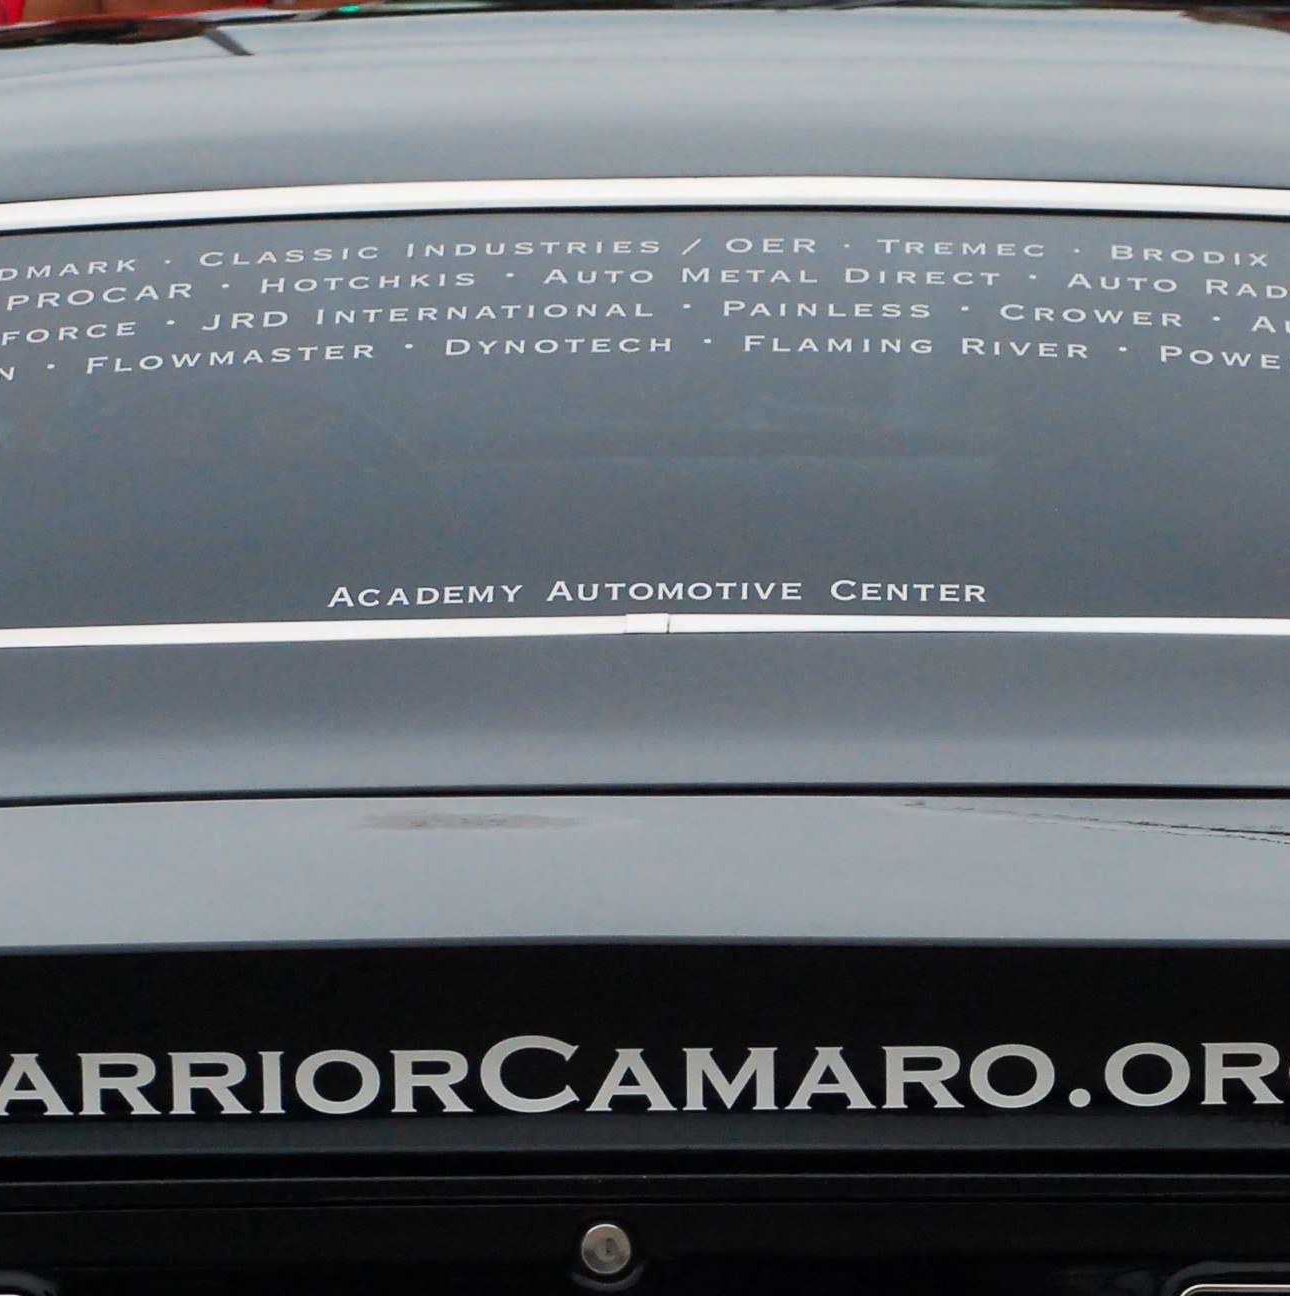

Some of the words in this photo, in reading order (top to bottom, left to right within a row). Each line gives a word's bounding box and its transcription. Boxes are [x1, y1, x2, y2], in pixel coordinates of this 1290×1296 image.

[199, 246, 379, 267] CLASSIC
[406, 240, 660, 258] INDUSTRIES
[725, 237, 816, 254] OER
[876, 239, 1044, 258] TREMEC
[1110, 244, 1268, 267] BRODIX
[6, 282, 192, 312] PROCAR
[260, 272, 475, 294] HOTCHKIS
[542, 268, 654, 285] AUTO
[681, 267, 818, 284] METAL
[844, 267, 1000, 286] DIRECT
[1067, 273, 1178, 293] AUTO
[1205, 278, 1288, 299] RAD
[201, 310, 289, 331] JRD
[316, 303, 654, 325] INTERNATIONAL
[723, 300, 930, 319] PAINLESS
[999, 303, 1183, 328] CROWER
[86, 344, 374, 375] FLOWMASTER
[444, 337, 672, 356] DYNOTECH
[743, 334, 933, 354] FLAMING
[961, 337, 1088, 359] RIVER
[327, 584, 523, 608] ACADEMY
[545, 580, 802, 602] AUTOMOTIVE
[830, 579, 987, 603] CENTER
